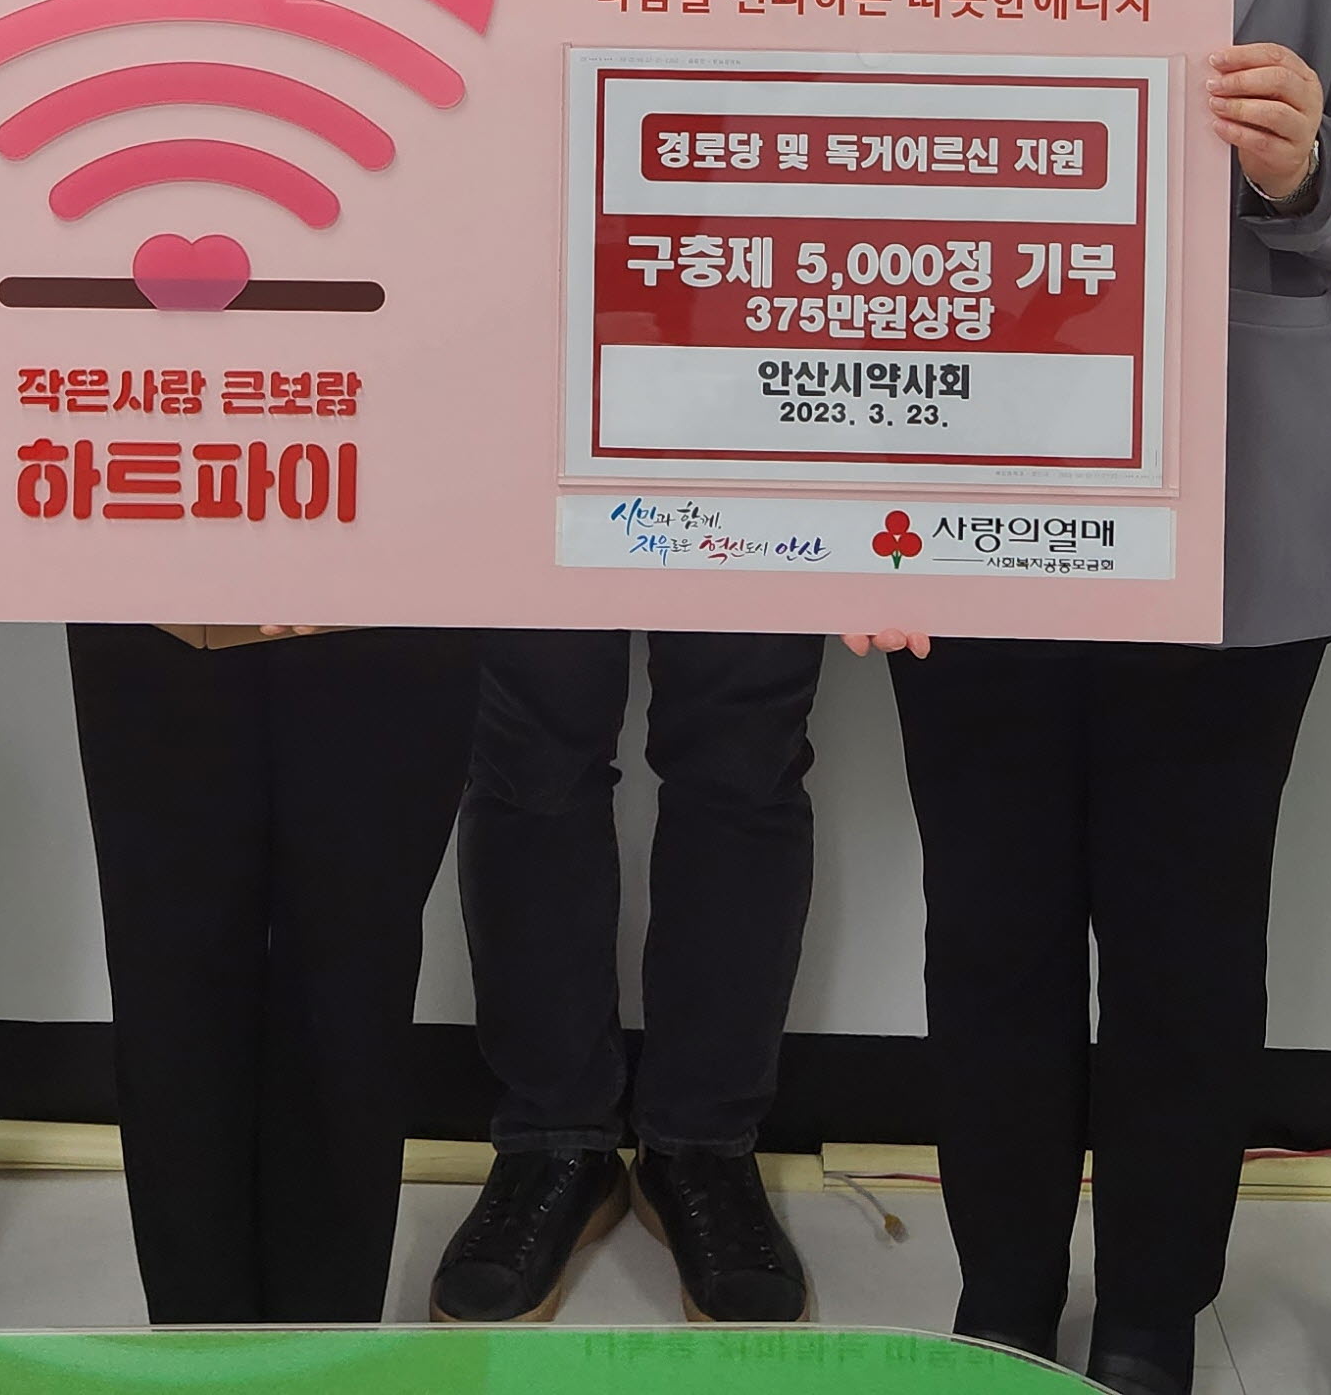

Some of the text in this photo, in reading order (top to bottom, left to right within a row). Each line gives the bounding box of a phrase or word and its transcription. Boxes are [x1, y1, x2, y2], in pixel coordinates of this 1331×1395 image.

[656, 130, 1085, 176] 경로당 및 독거어르신 지원
[626, 234, 1116, 296] 구충제 5,000정 기부
[745, 295, 995, 341] 375만원상당
[16, 367, 363, 418] 작은사랑 큰보람
[758, 360, 971, 400] 안산시약사회
[779, 401, 949, 429] 2023. 3. 23.
[16, 437, 358, 524] 하트파이
[610, 497, 676, 536] 시민과
[932, 516, 1116, 554] 사랑의열매
[628, 534, 832, 566] 자유로운 혁신도시 안산
[986, 556, 1114, 574] 사회복지공동모금회
